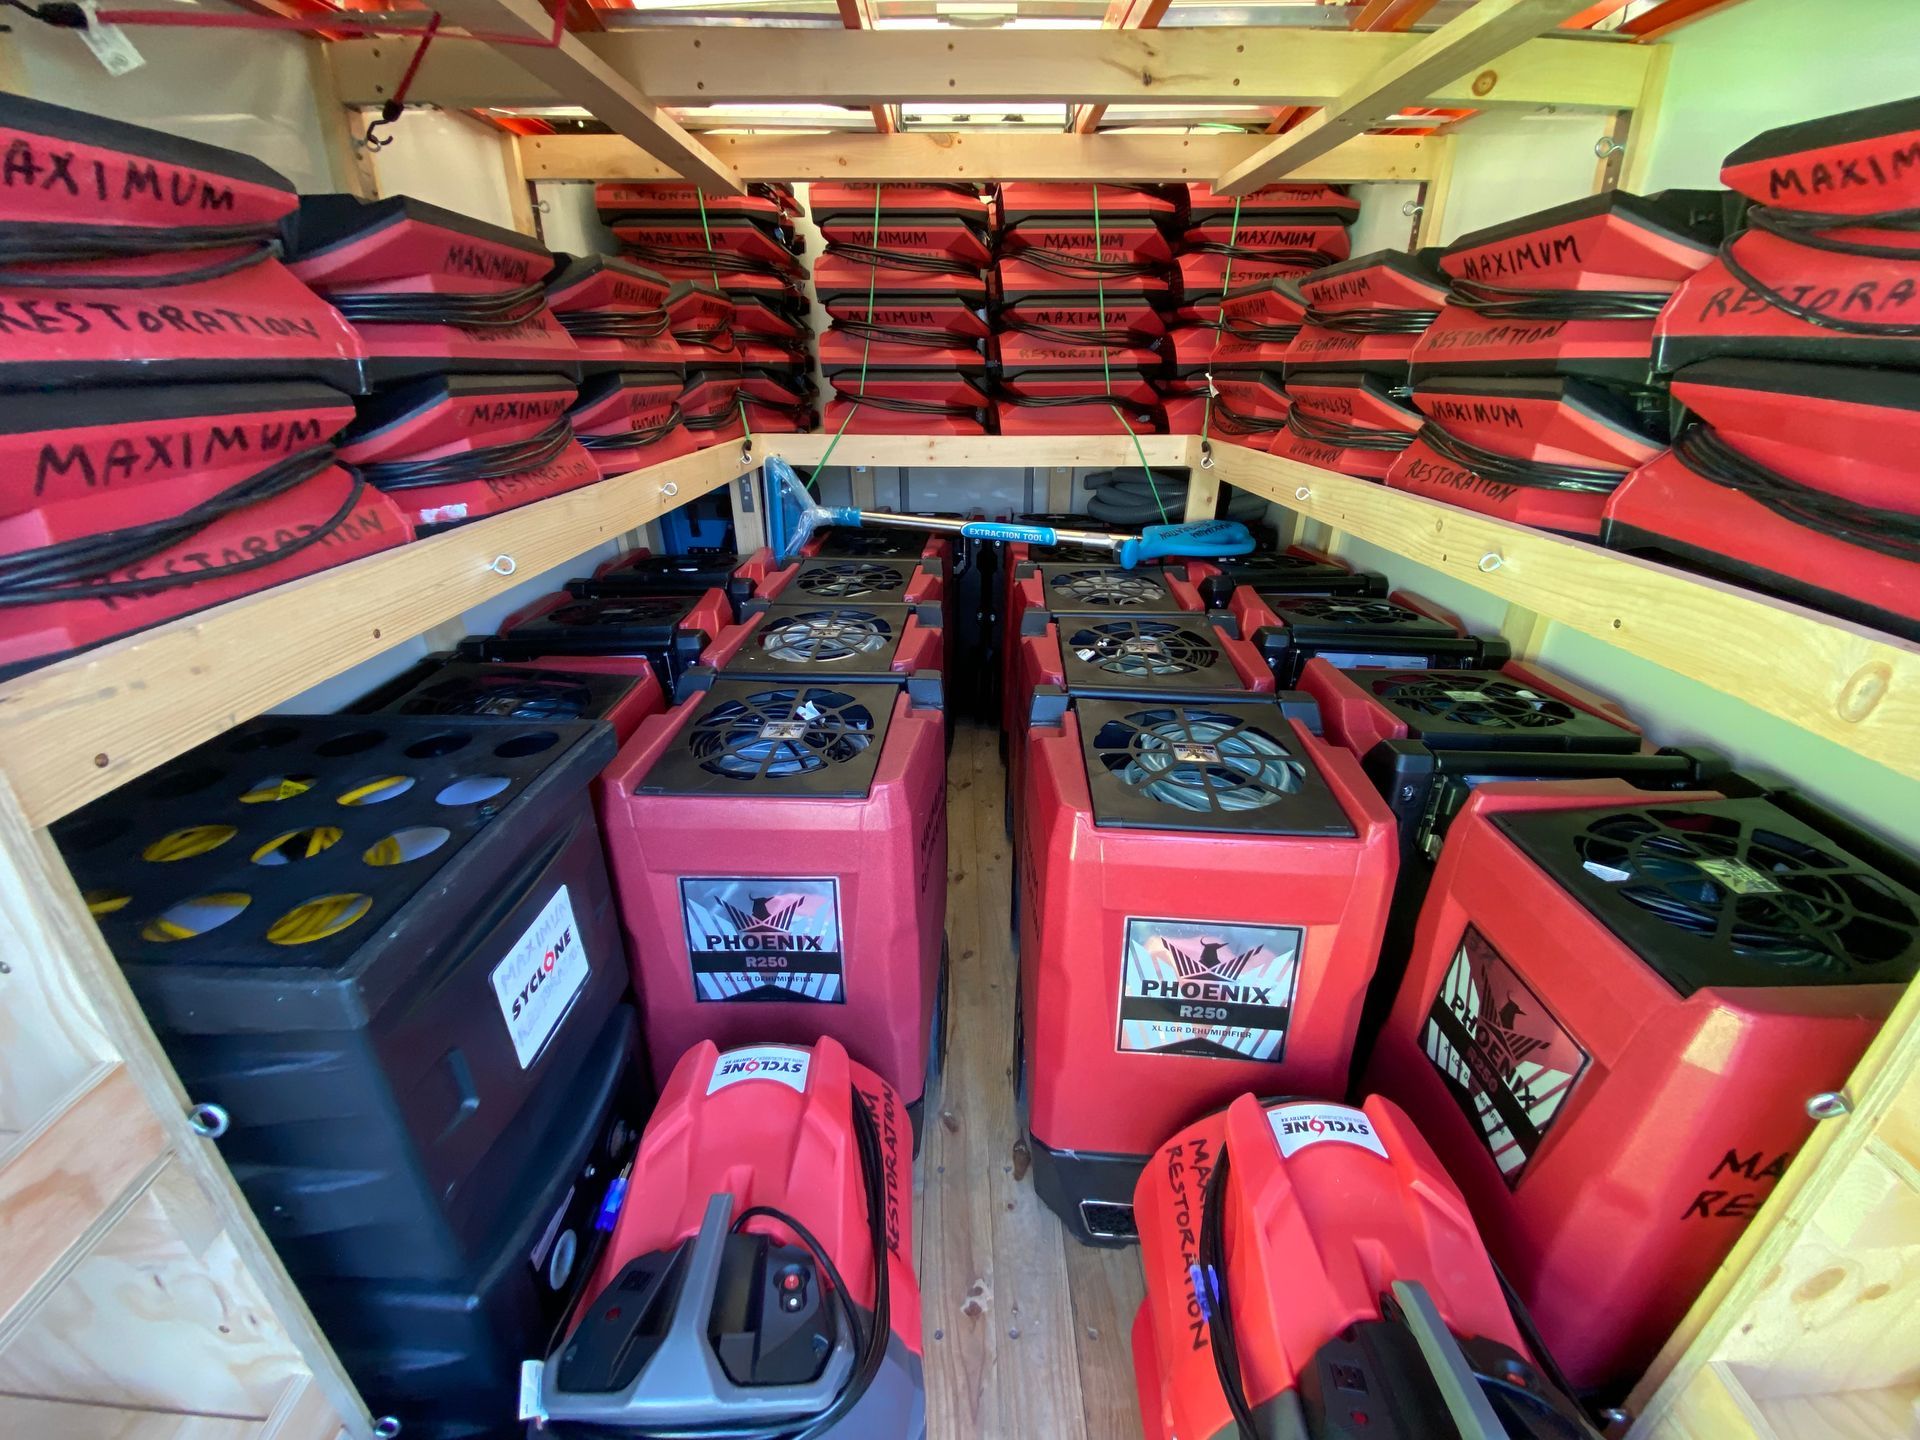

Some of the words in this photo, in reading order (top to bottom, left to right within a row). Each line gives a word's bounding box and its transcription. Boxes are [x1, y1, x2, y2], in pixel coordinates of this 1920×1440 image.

[1235, 230, 1315, 248] MAXIMUM
[1464, 235, 1581, 280] MAXIMUM
[1311, 276, 1370, 302] MAXIMUM
[471, 398, 566, 426] MAXIMUM
[1431, 401, 1523, 428] MAXIMUM
[34, 418, 321, 496] MAXIMUM
[1405, 458, 1518, 503] RESTORATION
[969, 527, 1020, 539] EXTRACTION
[1023, 533, 1043, 542] TOOL
[706, 934, 822, 951] PHOENIX
[511, 926, 572, 1022] SYCLONE
[746, 956, 788, 968] R250
[1141, 979, 1271, 1005] PHOENIX
[1179, 1005, 1228, 1020] R250
[1185, 1028, 1252, 1039] DEHUMIDIFIER
[1450, 994, 1537, 1114] PHOENIX
[719, 1060, 803, 1076] SYCLONE
[1282, 1116, 1370, 1137] SYCLONE
